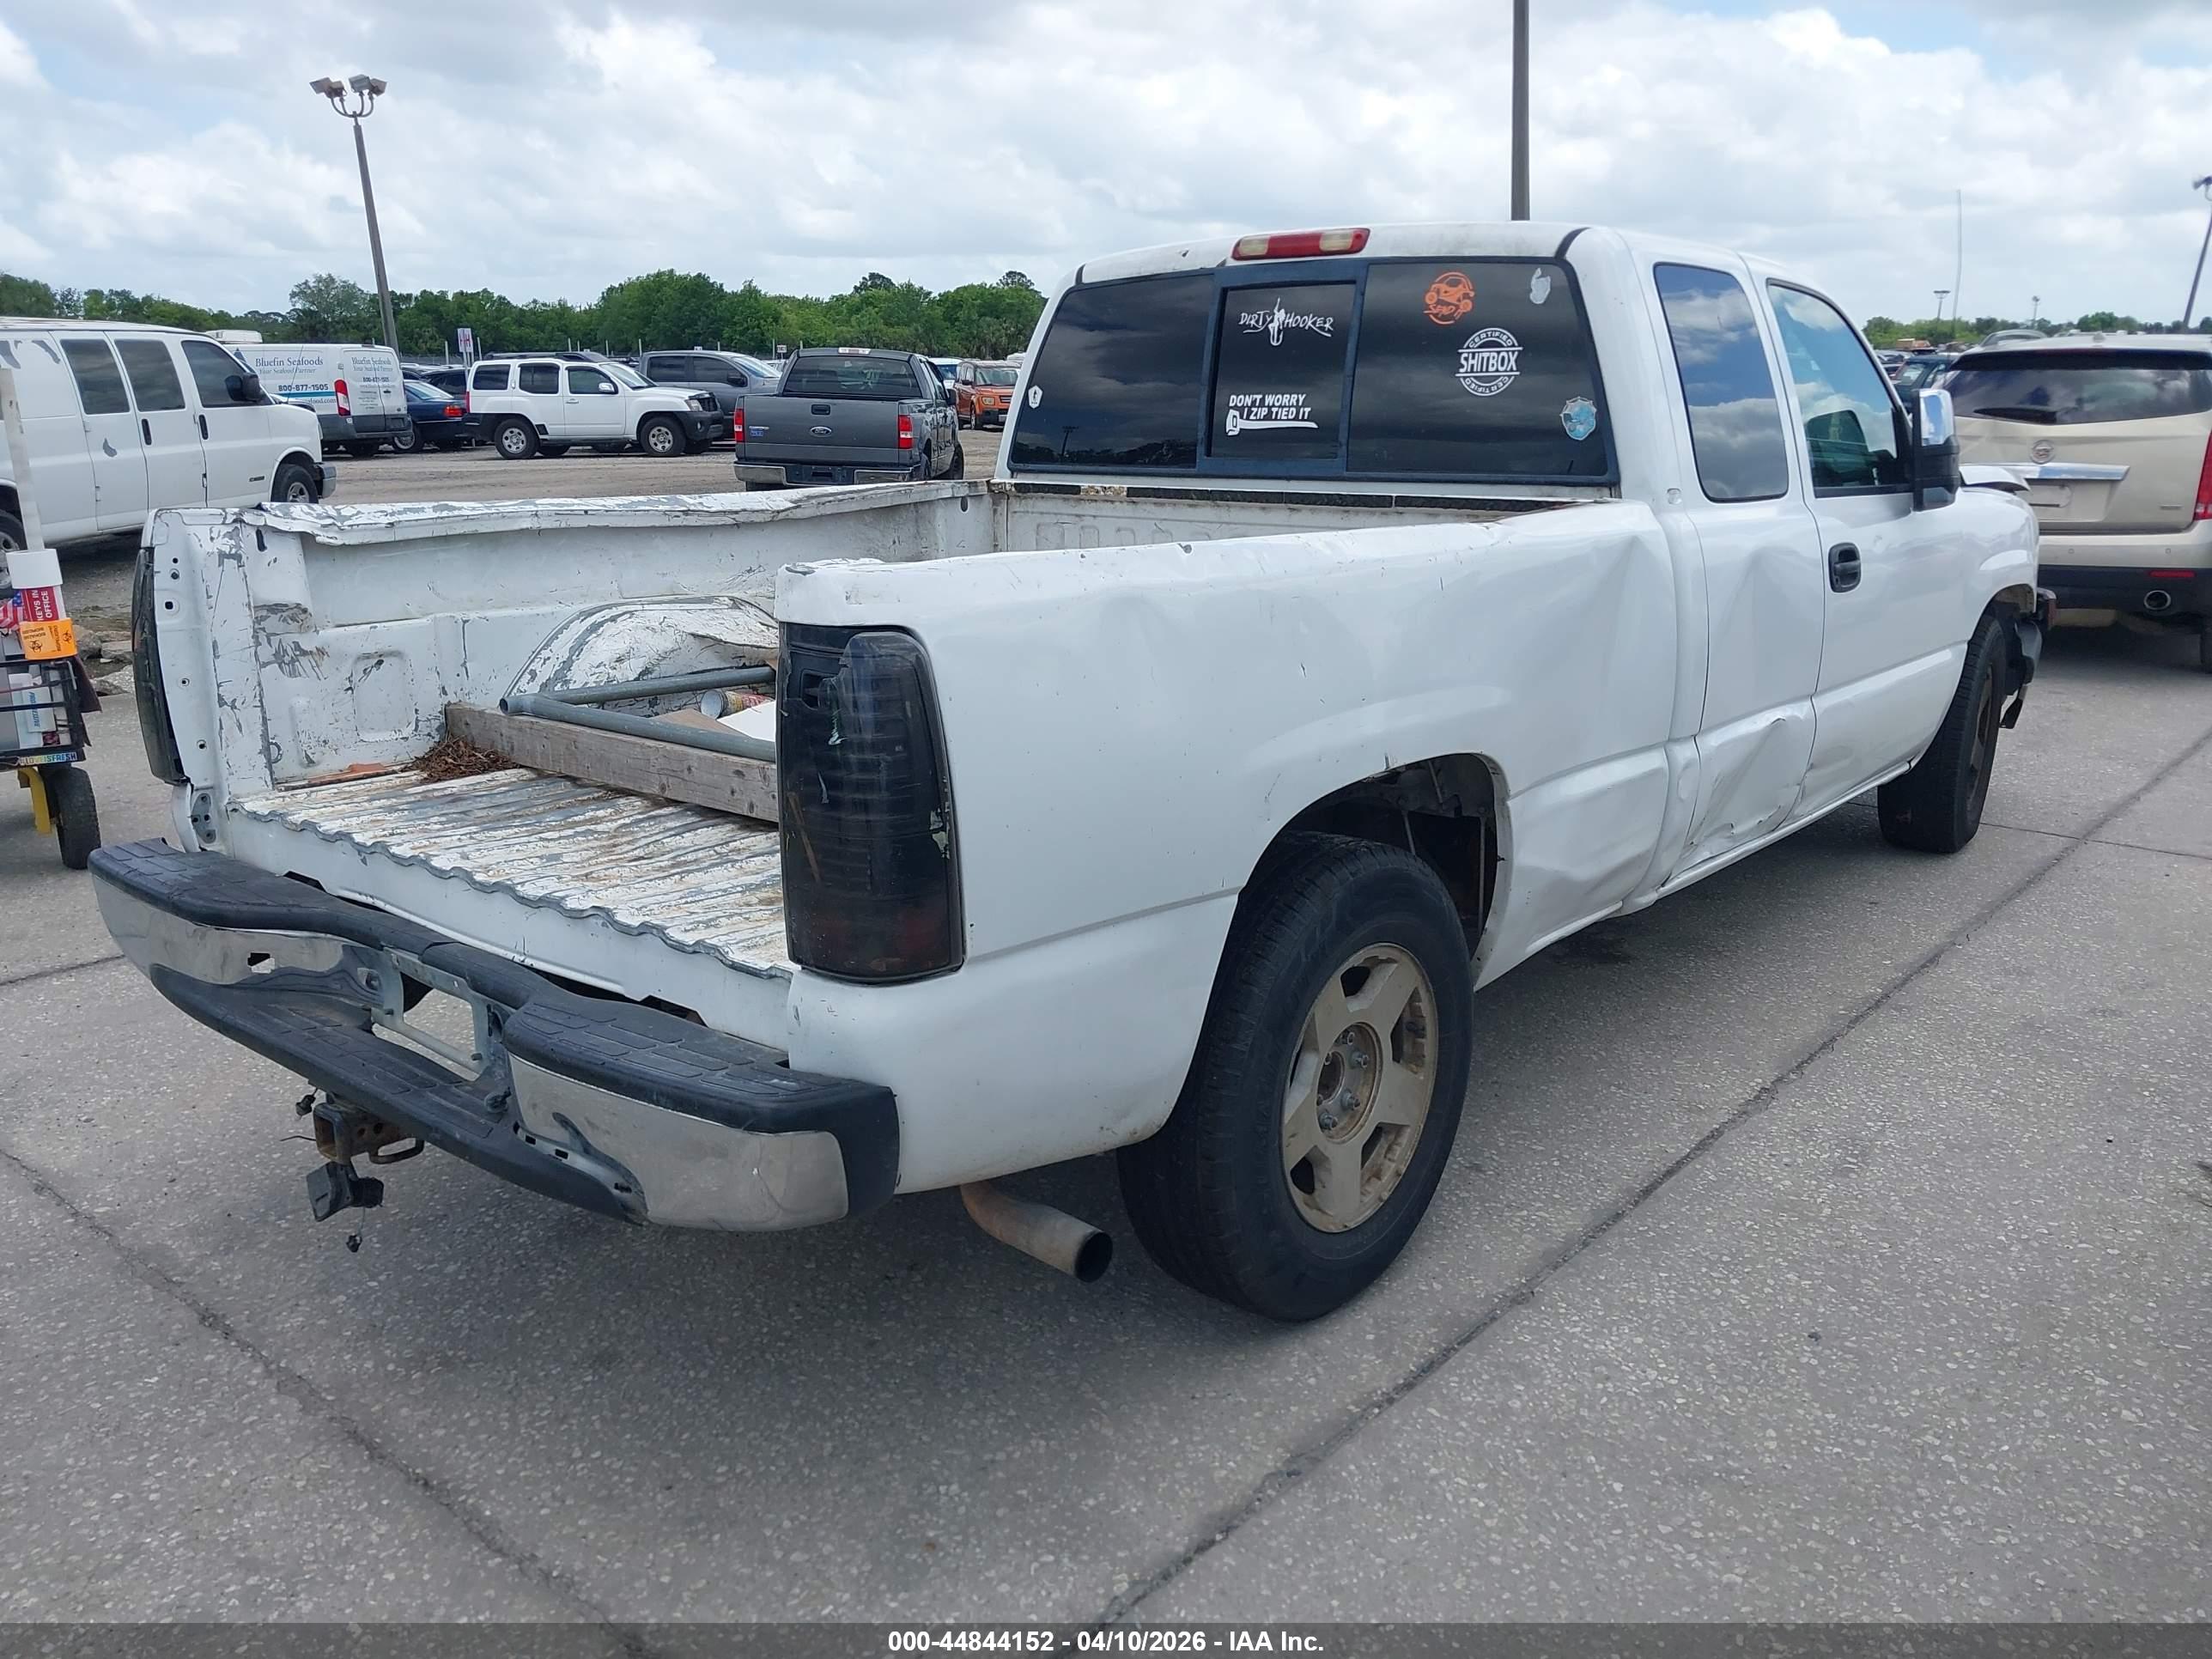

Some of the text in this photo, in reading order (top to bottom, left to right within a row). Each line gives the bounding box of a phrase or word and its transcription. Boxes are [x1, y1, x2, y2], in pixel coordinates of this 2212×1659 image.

[1238, 310, 1334, 337] DIRTY HOOKER
[1468, 331, 1513, 348] CERTIFIED
[255, 356, 323, 367] Bluefin Seafoods
[1459, 351, 1518, 373] SHITBOX
[1465, 376, 1509, 393] CERTIFIED
[1229, 394, 1306, 407] DON'T WORRY
[1243, 407, 1312, 419] I ZIP TIED IT
[31, 589, 44, 621] KEYS IN
[41, 590, 53, 618] OFFICE
